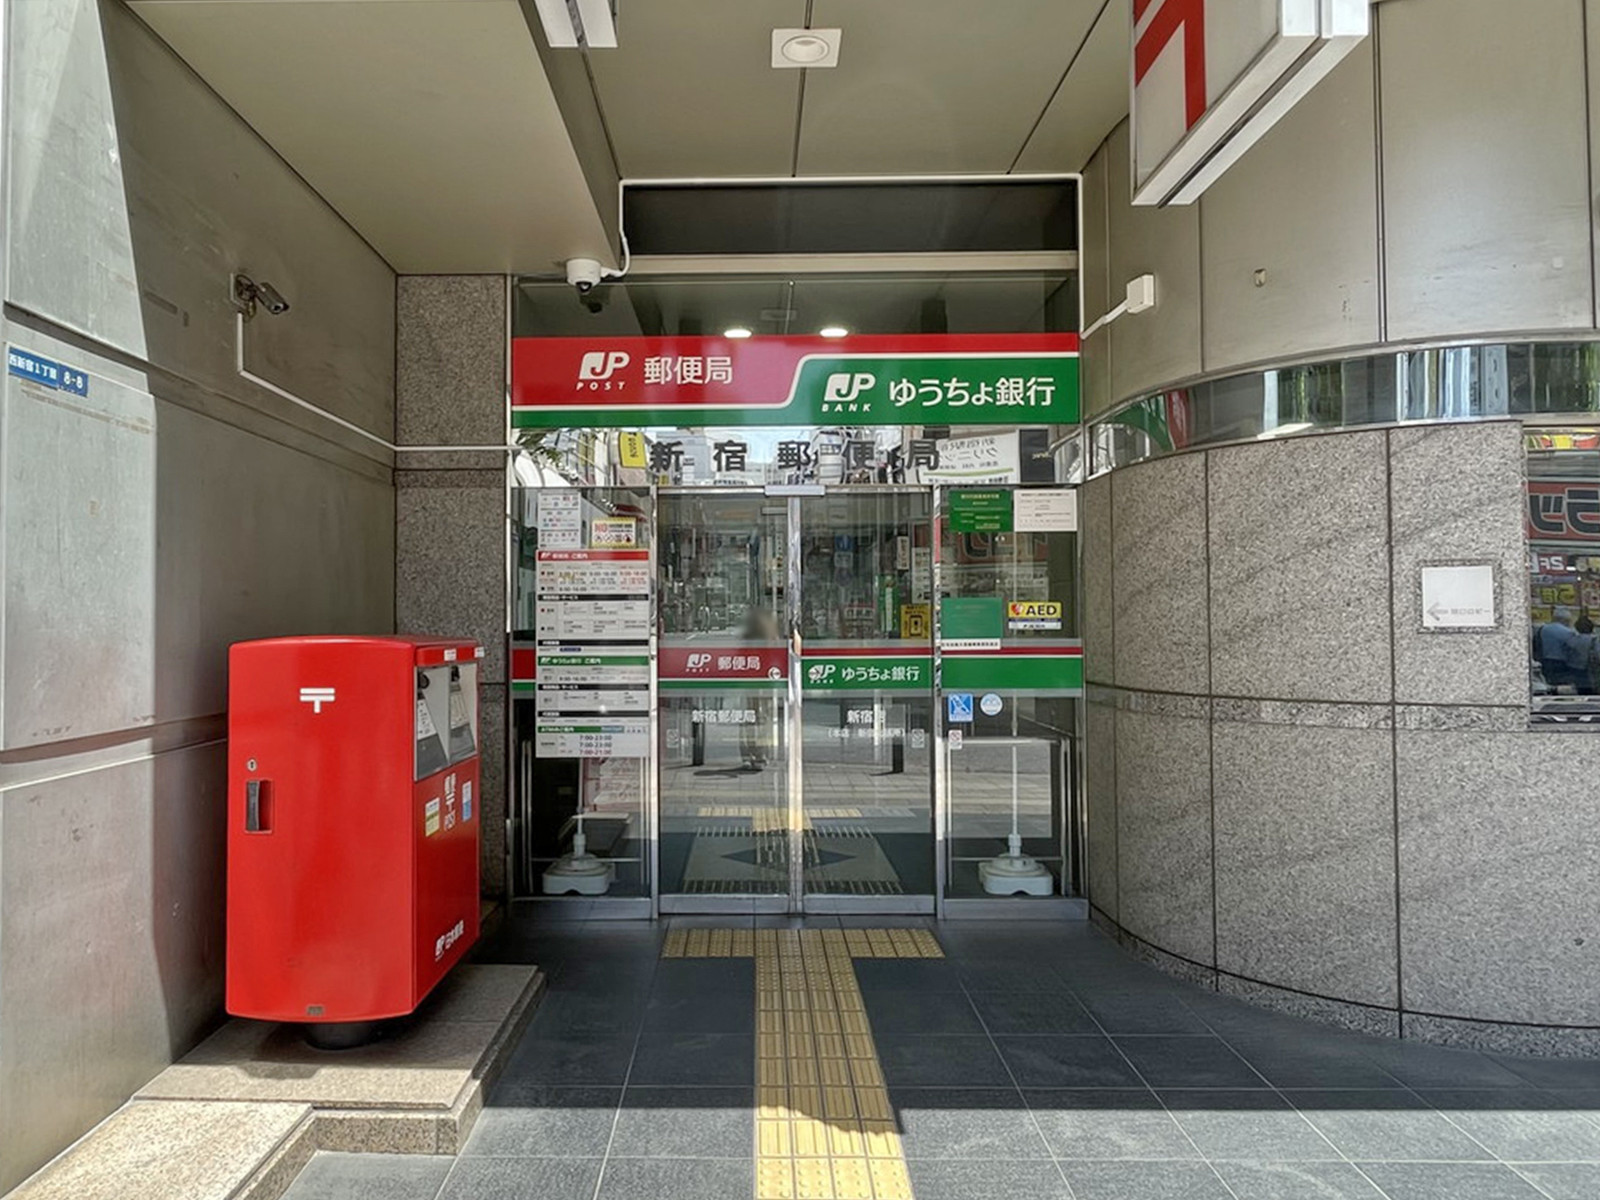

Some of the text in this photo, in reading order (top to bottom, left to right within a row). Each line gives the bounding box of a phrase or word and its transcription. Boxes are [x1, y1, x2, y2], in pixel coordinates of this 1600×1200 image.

[643, 356, 733, 385] 郵便局
[576, 381, 627, 391] POST
[889, 377, 1056, 407] ゆうちょ銀行
[821, 403, 872, 412] BANK
[649, 439, 940, 472] 新宿郵便局
[1026, 605, 1058, 615] AED
[717, 656, 761, 671] 郵便局
[841, 666, 920, 682] ゆうちょ銀行
[692, 709, 757, 723] 新宿郵便局
